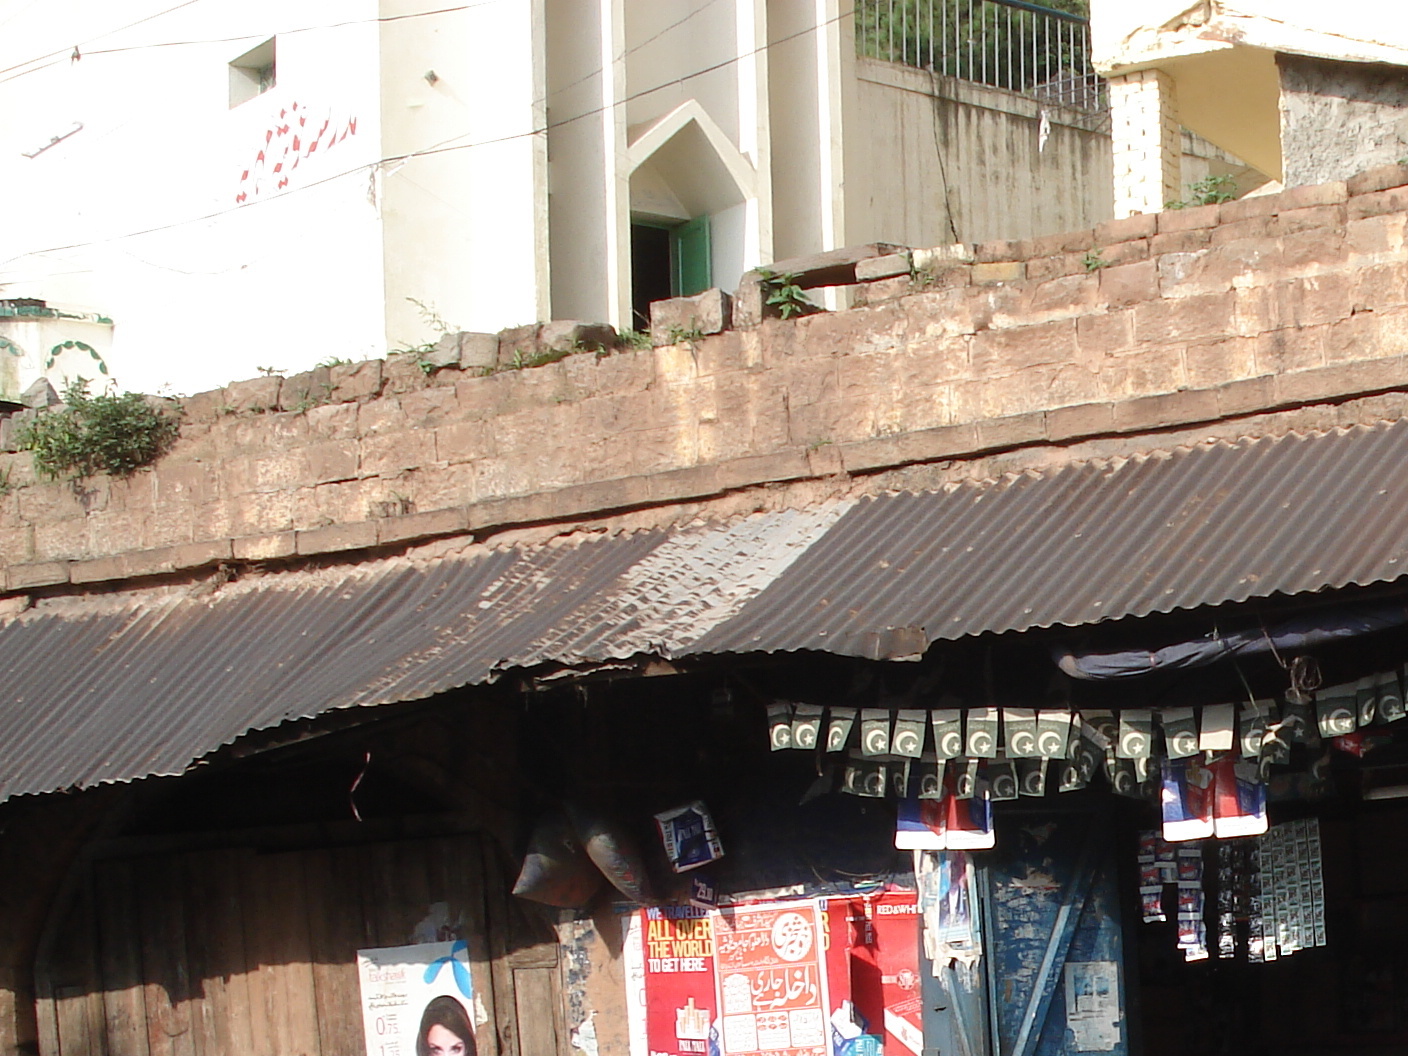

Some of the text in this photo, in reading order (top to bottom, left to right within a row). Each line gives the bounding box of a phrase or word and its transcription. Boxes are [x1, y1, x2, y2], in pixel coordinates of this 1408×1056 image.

[662, 905, 710, 919] TRAVELLE
[648, 919, 674, 941] ALL
[676, 918, 712, 941] OVER
[648, 940, 713, 959] THE WORLD
[648, 958, 661, 973] TO
[661, 958, 680, 973] GET
